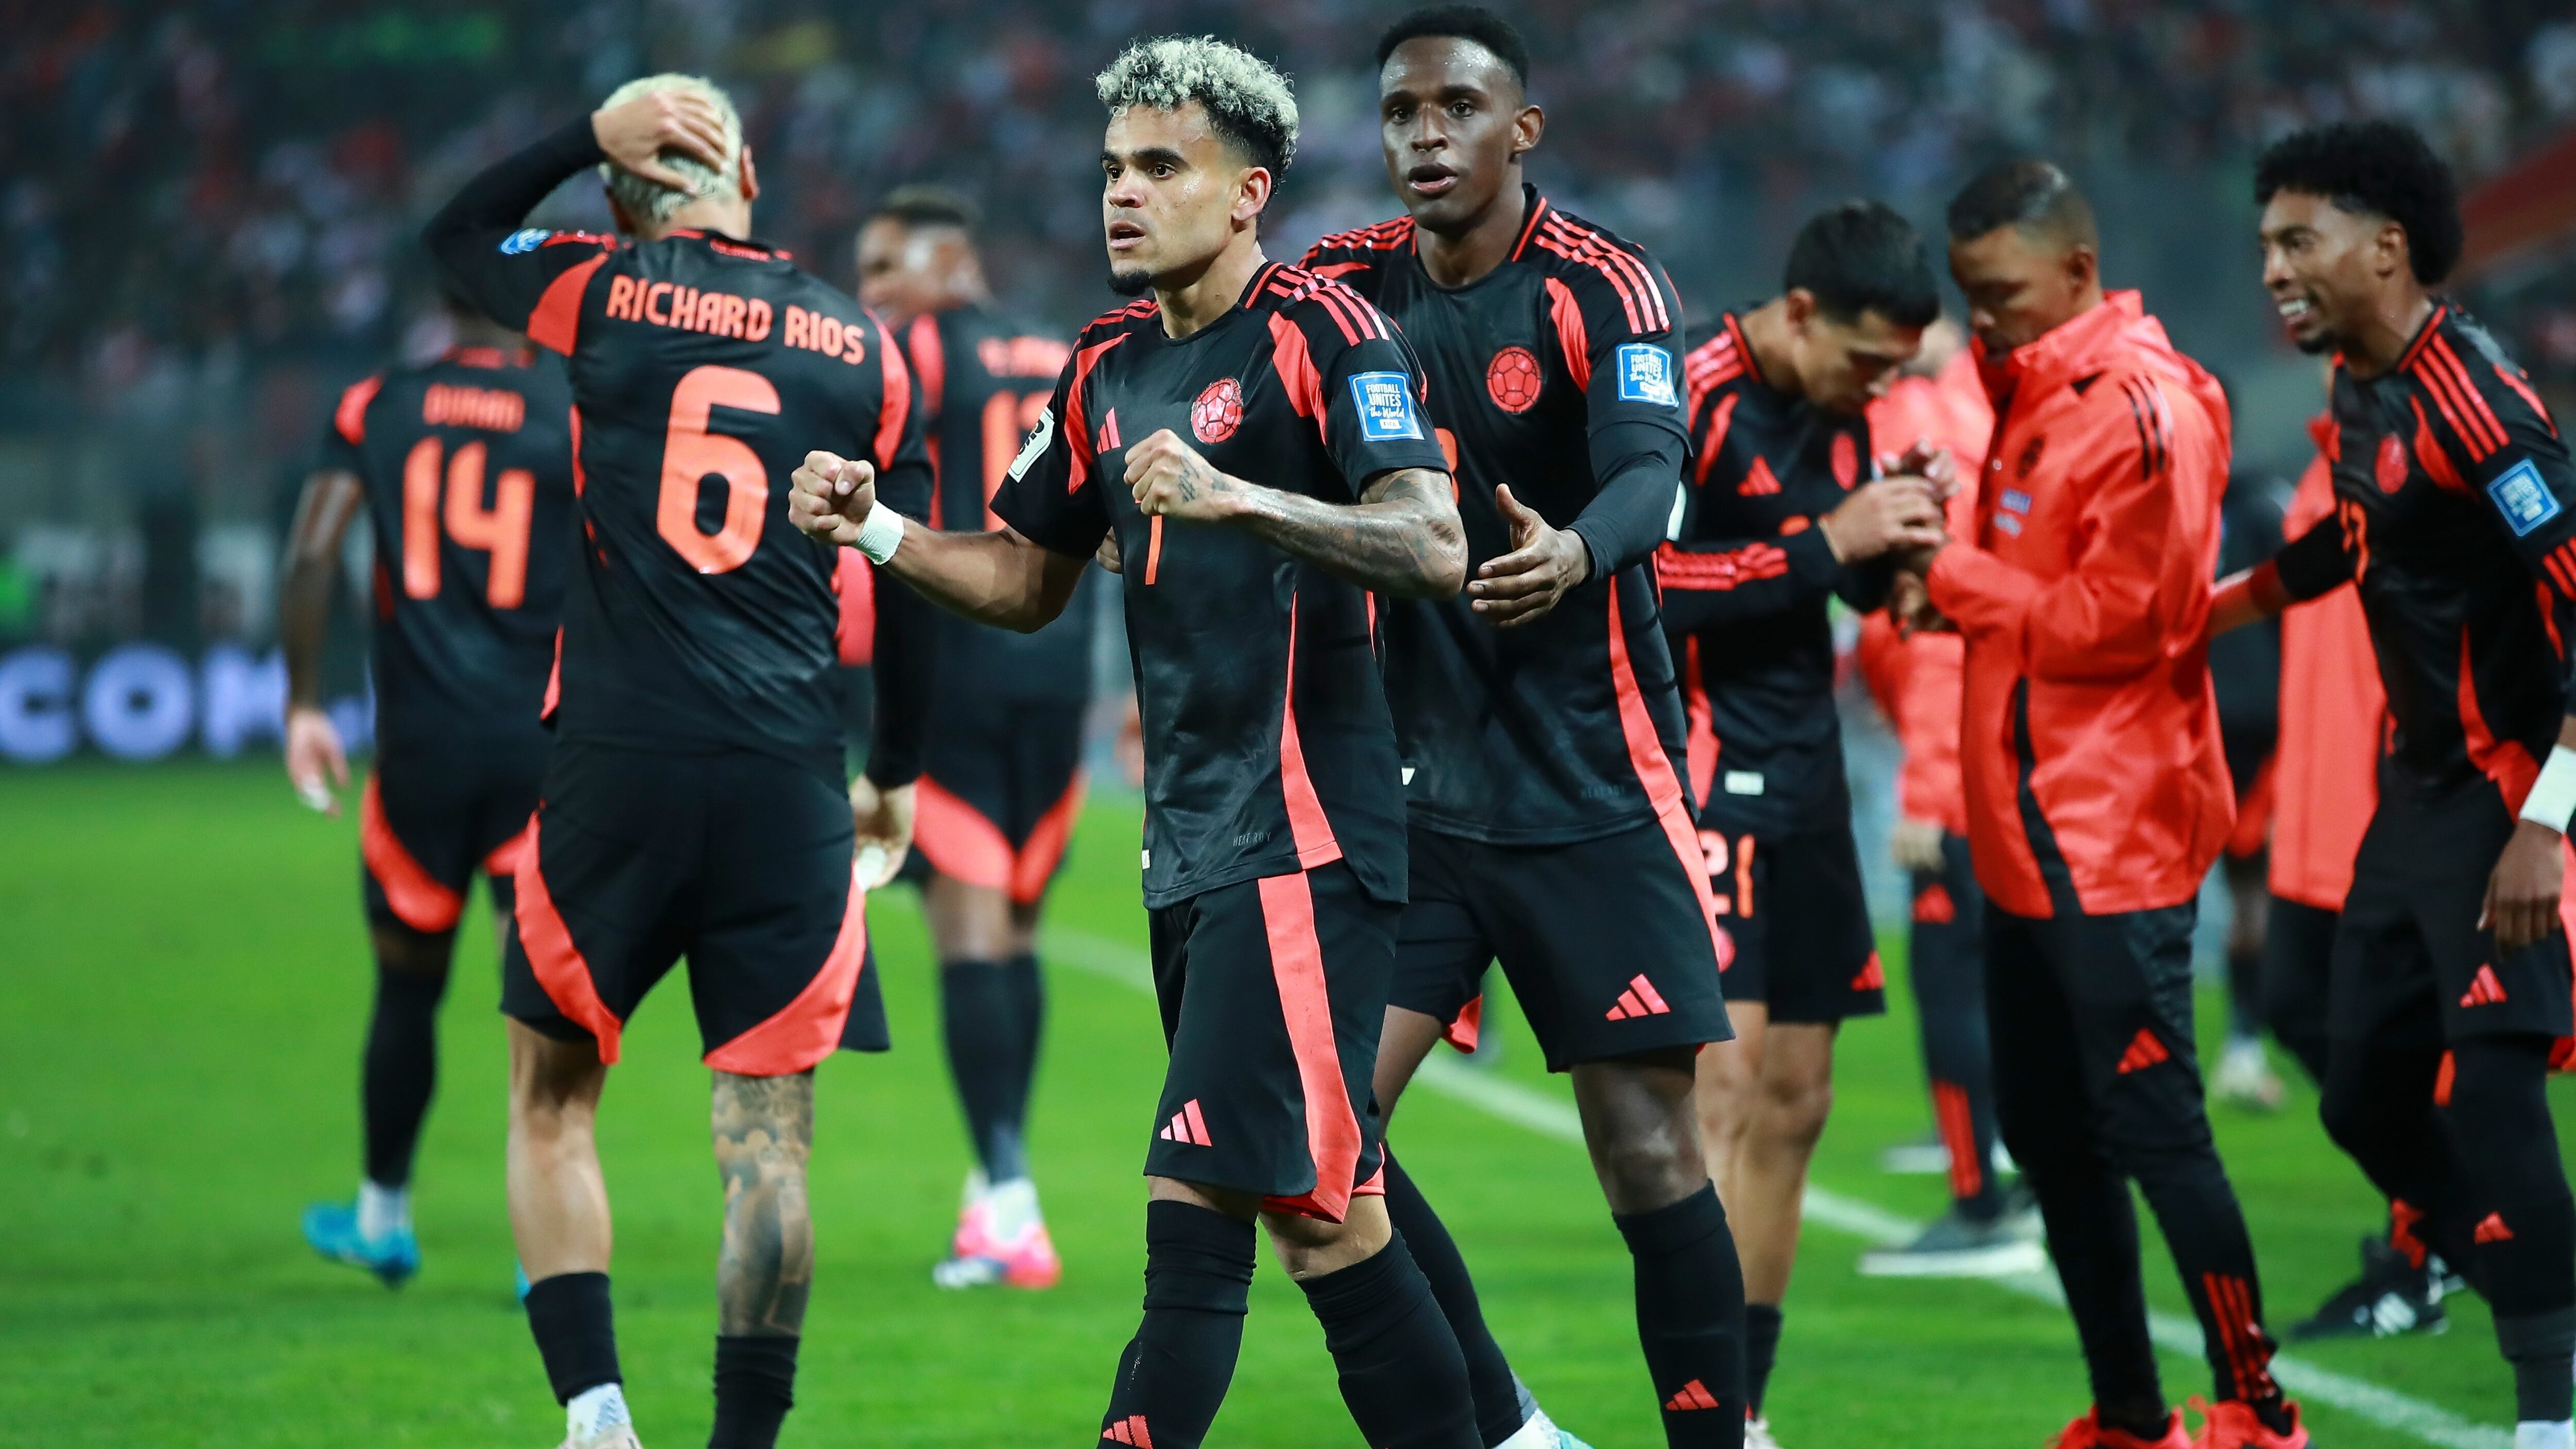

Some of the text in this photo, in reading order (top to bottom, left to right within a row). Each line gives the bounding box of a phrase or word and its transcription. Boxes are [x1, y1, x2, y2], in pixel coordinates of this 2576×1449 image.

[605, 274, 866, 366] RICHARD RIOS
[1365, 383, 1400, 394] FOOTBALL
[1368, 393, 1402, 407] UNITES
[1368, 406, 1405, 419] the World
[656, 364, 782, 575] 6
[402, 435, 536, 610] 14
